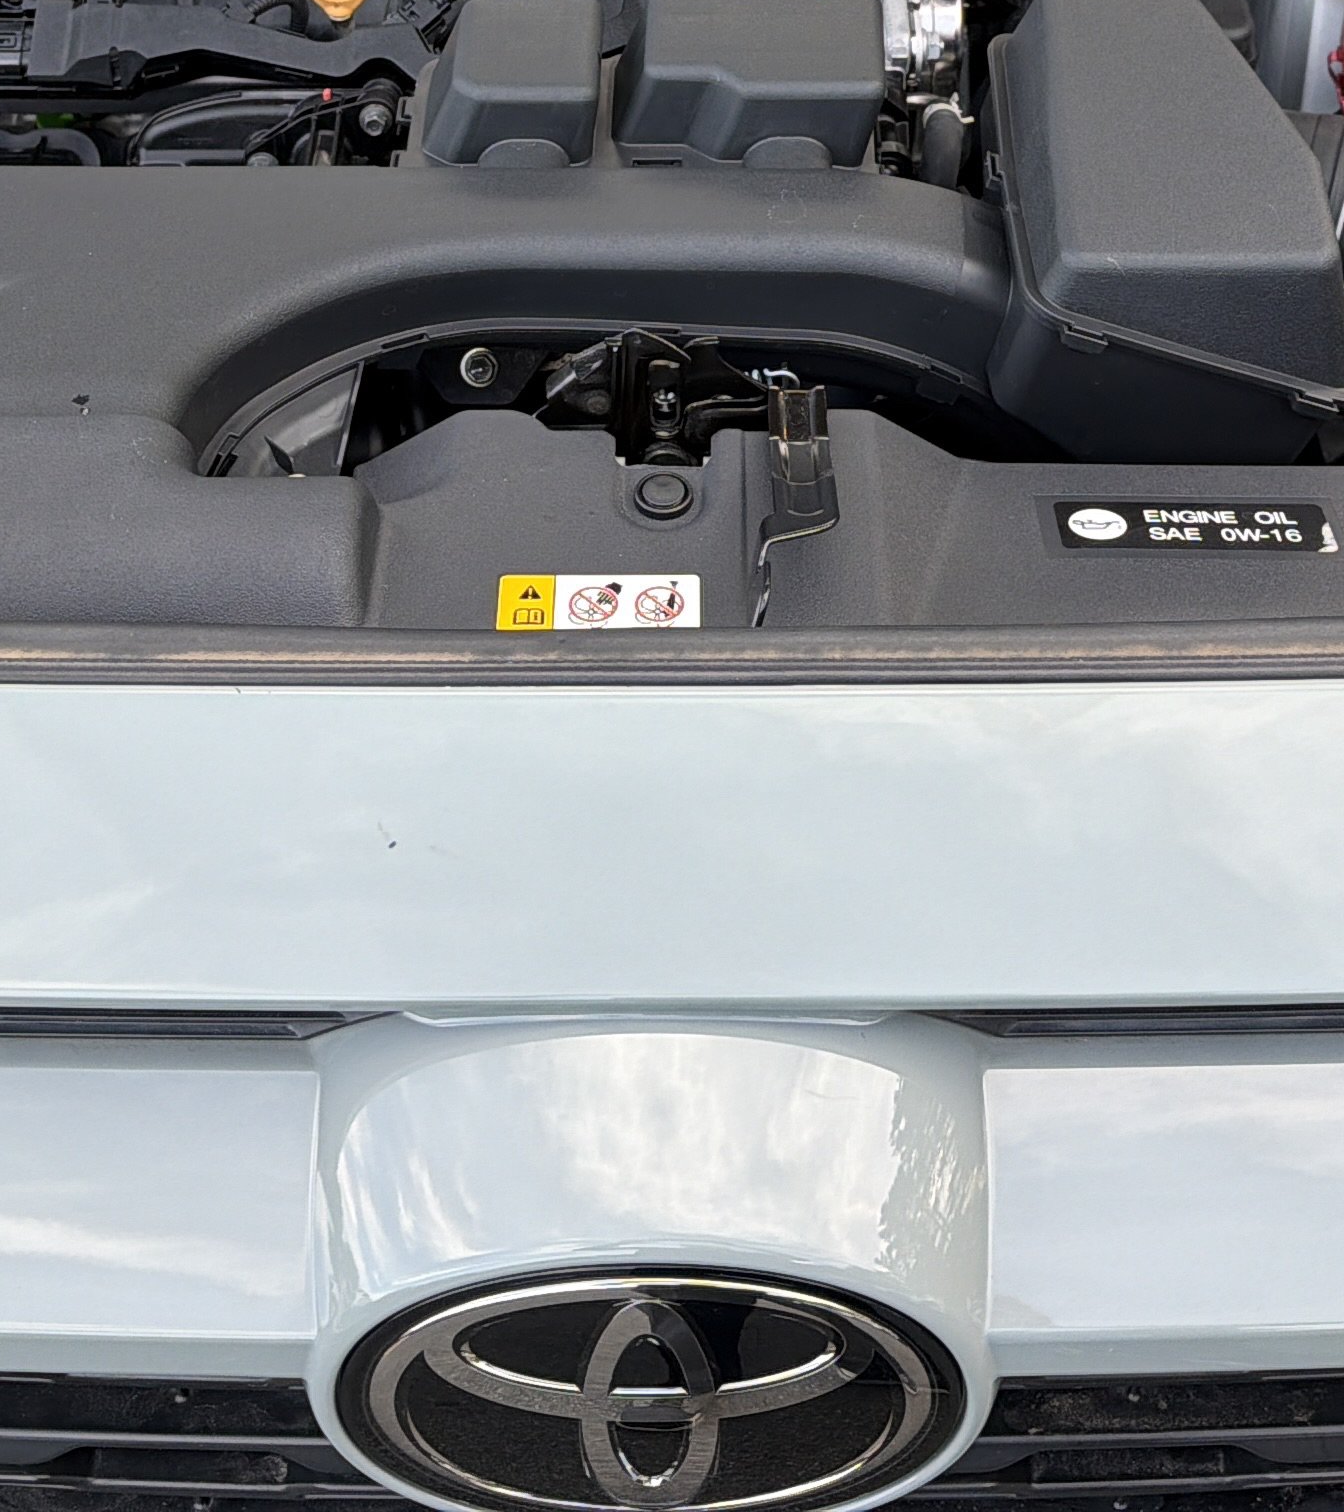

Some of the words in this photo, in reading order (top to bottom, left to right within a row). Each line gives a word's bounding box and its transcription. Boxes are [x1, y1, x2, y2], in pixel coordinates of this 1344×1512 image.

[1142, 509, 1238, 525] ENGINE
[1254, 511, 1298, 525] OIL
[1148, 527, 1203, 542] SAE
[1220, 527, 1303, 543] 0W-16
